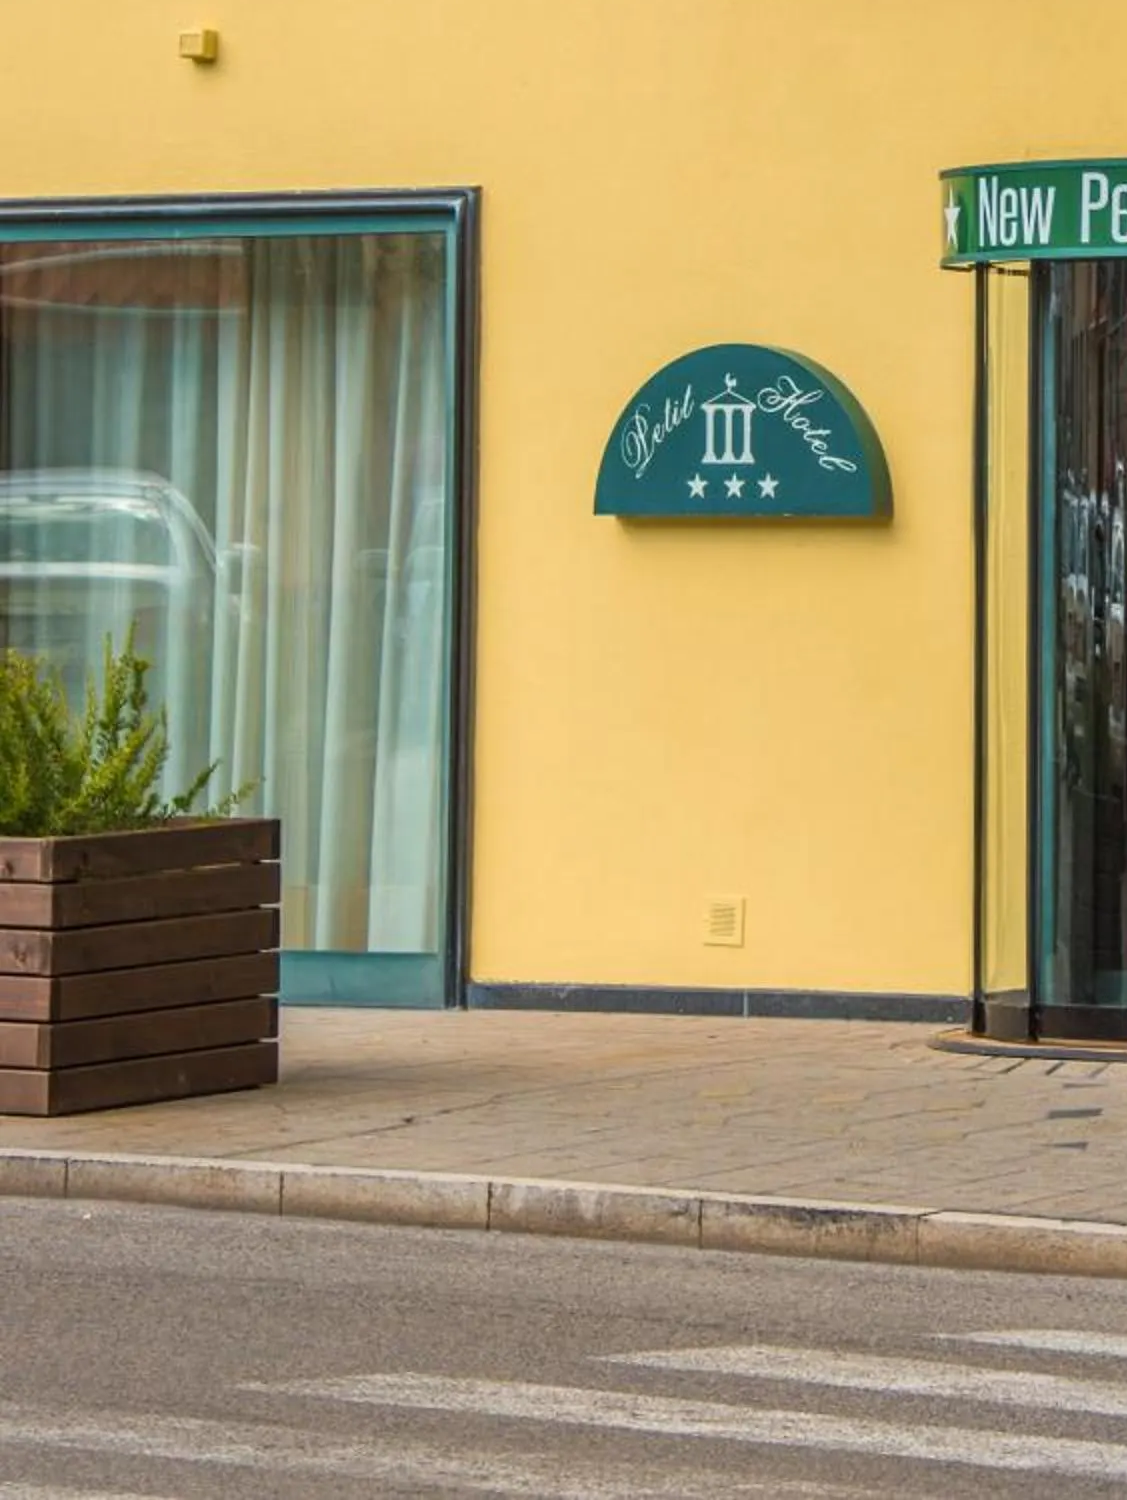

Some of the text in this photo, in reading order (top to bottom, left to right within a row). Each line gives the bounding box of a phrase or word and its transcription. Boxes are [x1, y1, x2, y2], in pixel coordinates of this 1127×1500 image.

[979, 175, 1056, 247] New
[621, 375, 857, 479] Petit Hotel
